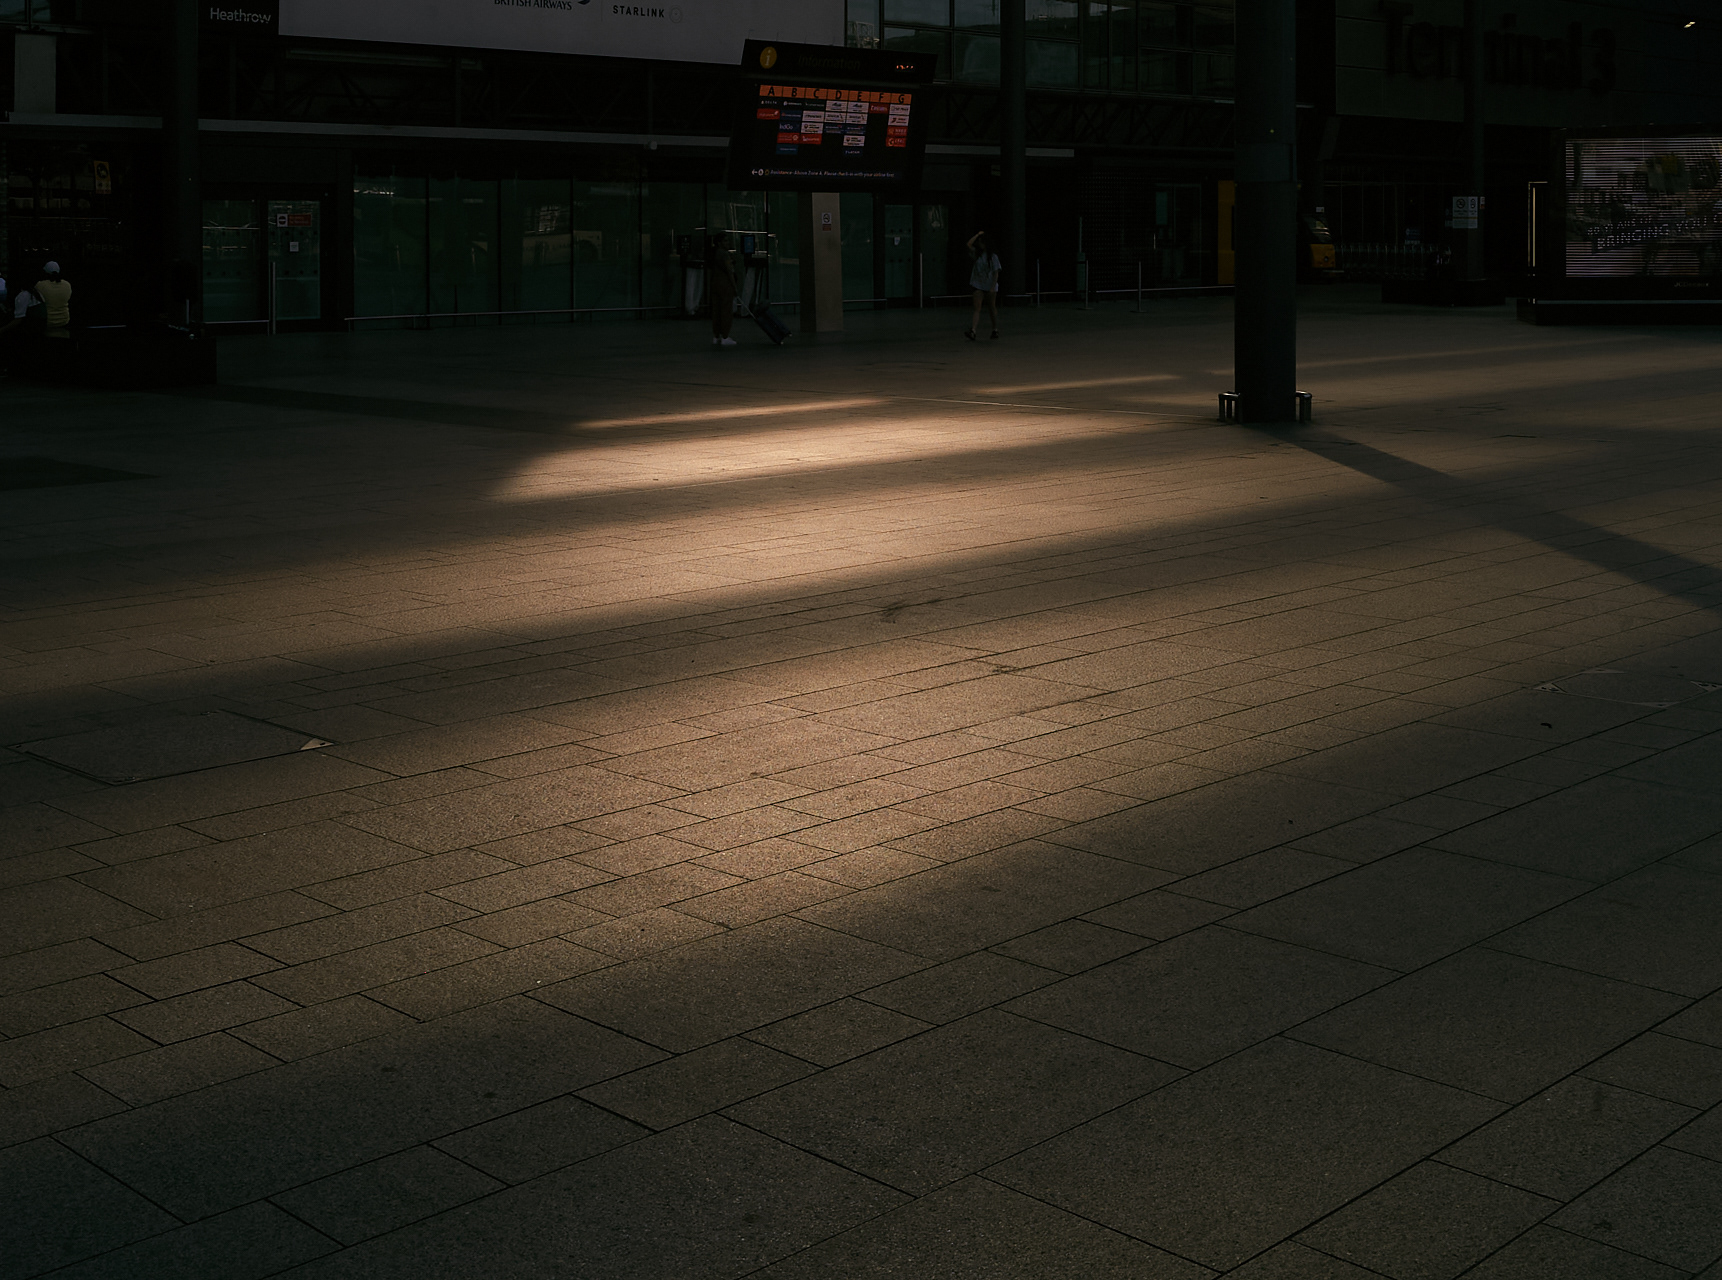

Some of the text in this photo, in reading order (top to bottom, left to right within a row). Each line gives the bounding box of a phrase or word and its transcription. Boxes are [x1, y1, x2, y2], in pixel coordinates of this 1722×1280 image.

[209, 7, 272, 24] Heathrow
[613, 5, 664, 18] STARLINK
[1590, 28, 1616, 97] 3
[768, 86, 905, 104] A B C D E F G
[1597, 222, 1670, 250] BRINGING
